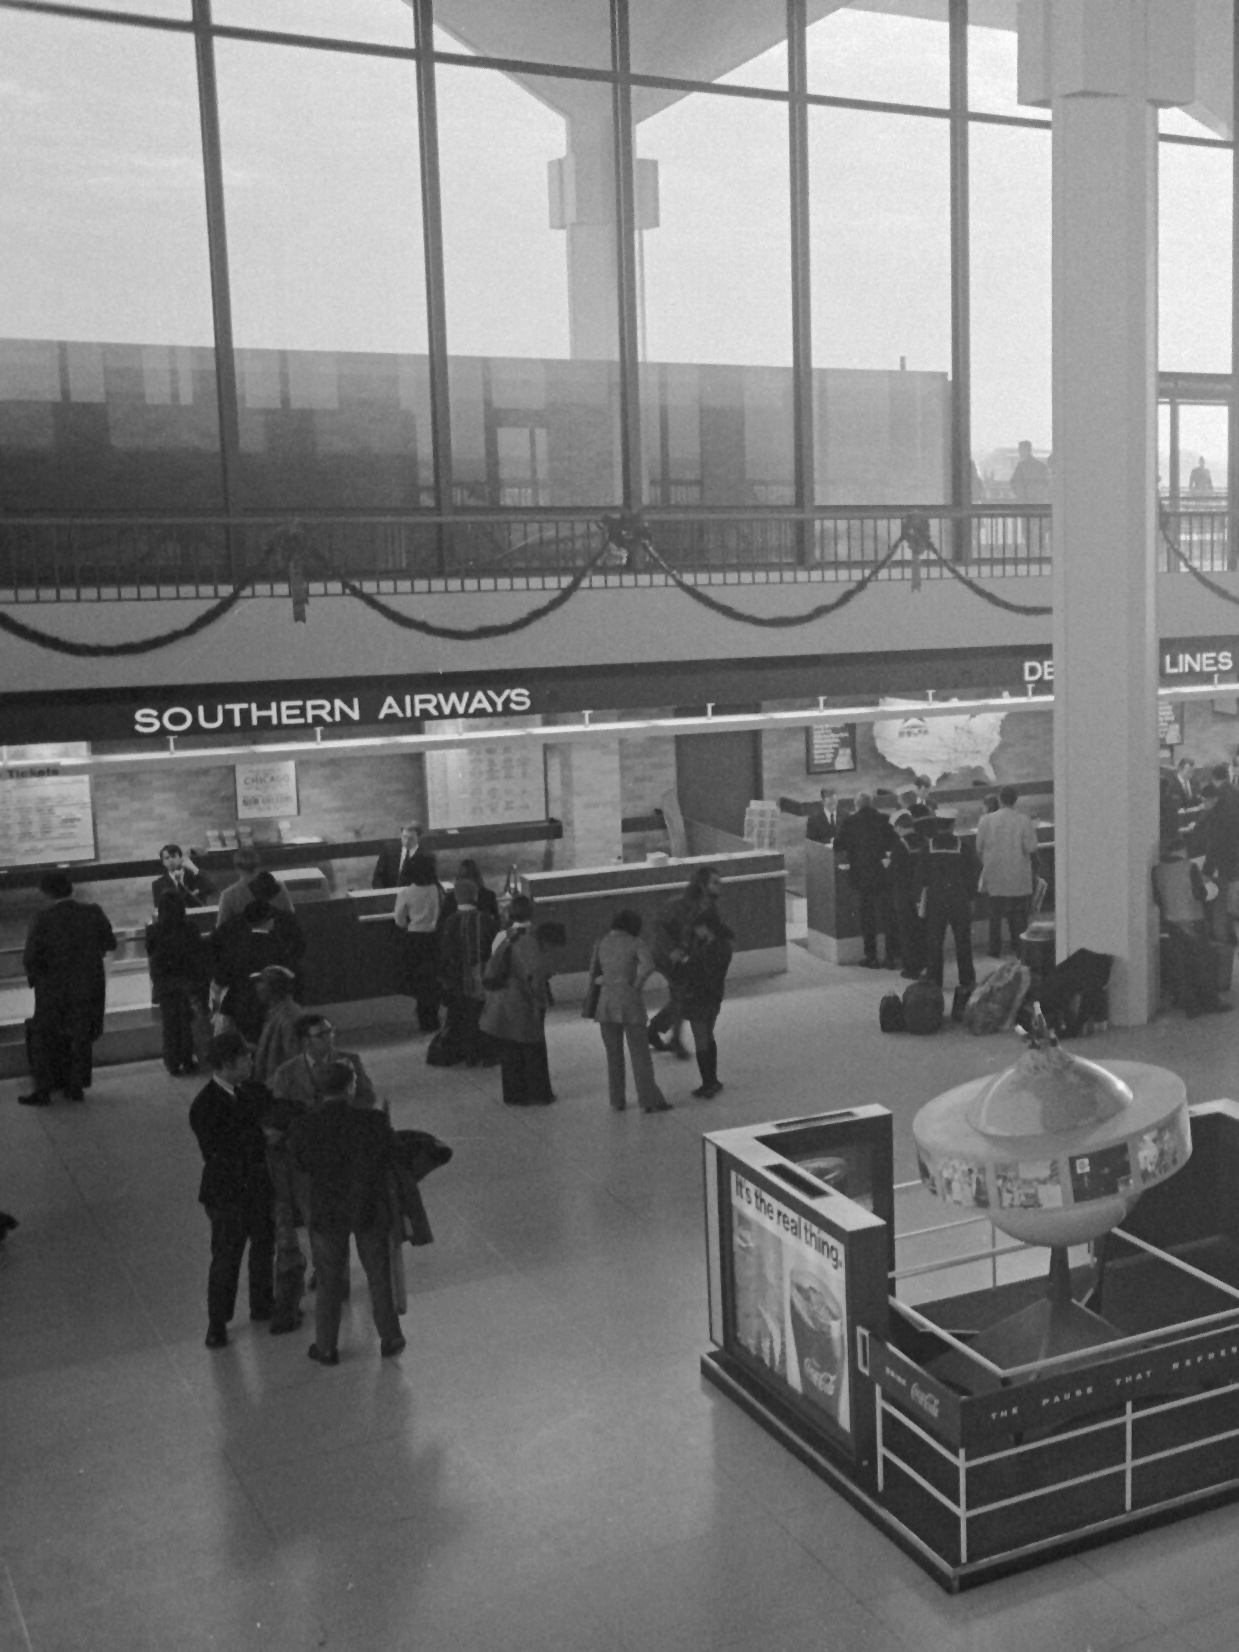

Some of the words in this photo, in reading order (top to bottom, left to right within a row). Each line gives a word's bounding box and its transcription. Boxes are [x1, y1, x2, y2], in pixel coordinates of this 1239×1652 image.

[1165, 651, 1233, 674] LINES
[134, 698, 360, 733] SOUTHERN
[378, 688, 532, 720] AIRWAYS
[735, 1174, 752, 1205] It's
[754, 1188, 775, 1221] the
[776, 1209, 802, 1241] real
[803, 1222, 843, 1270] thing.
[991, 1406, 1019, 1420] THE
[1115, 1369, 1152, 1386] THAT
